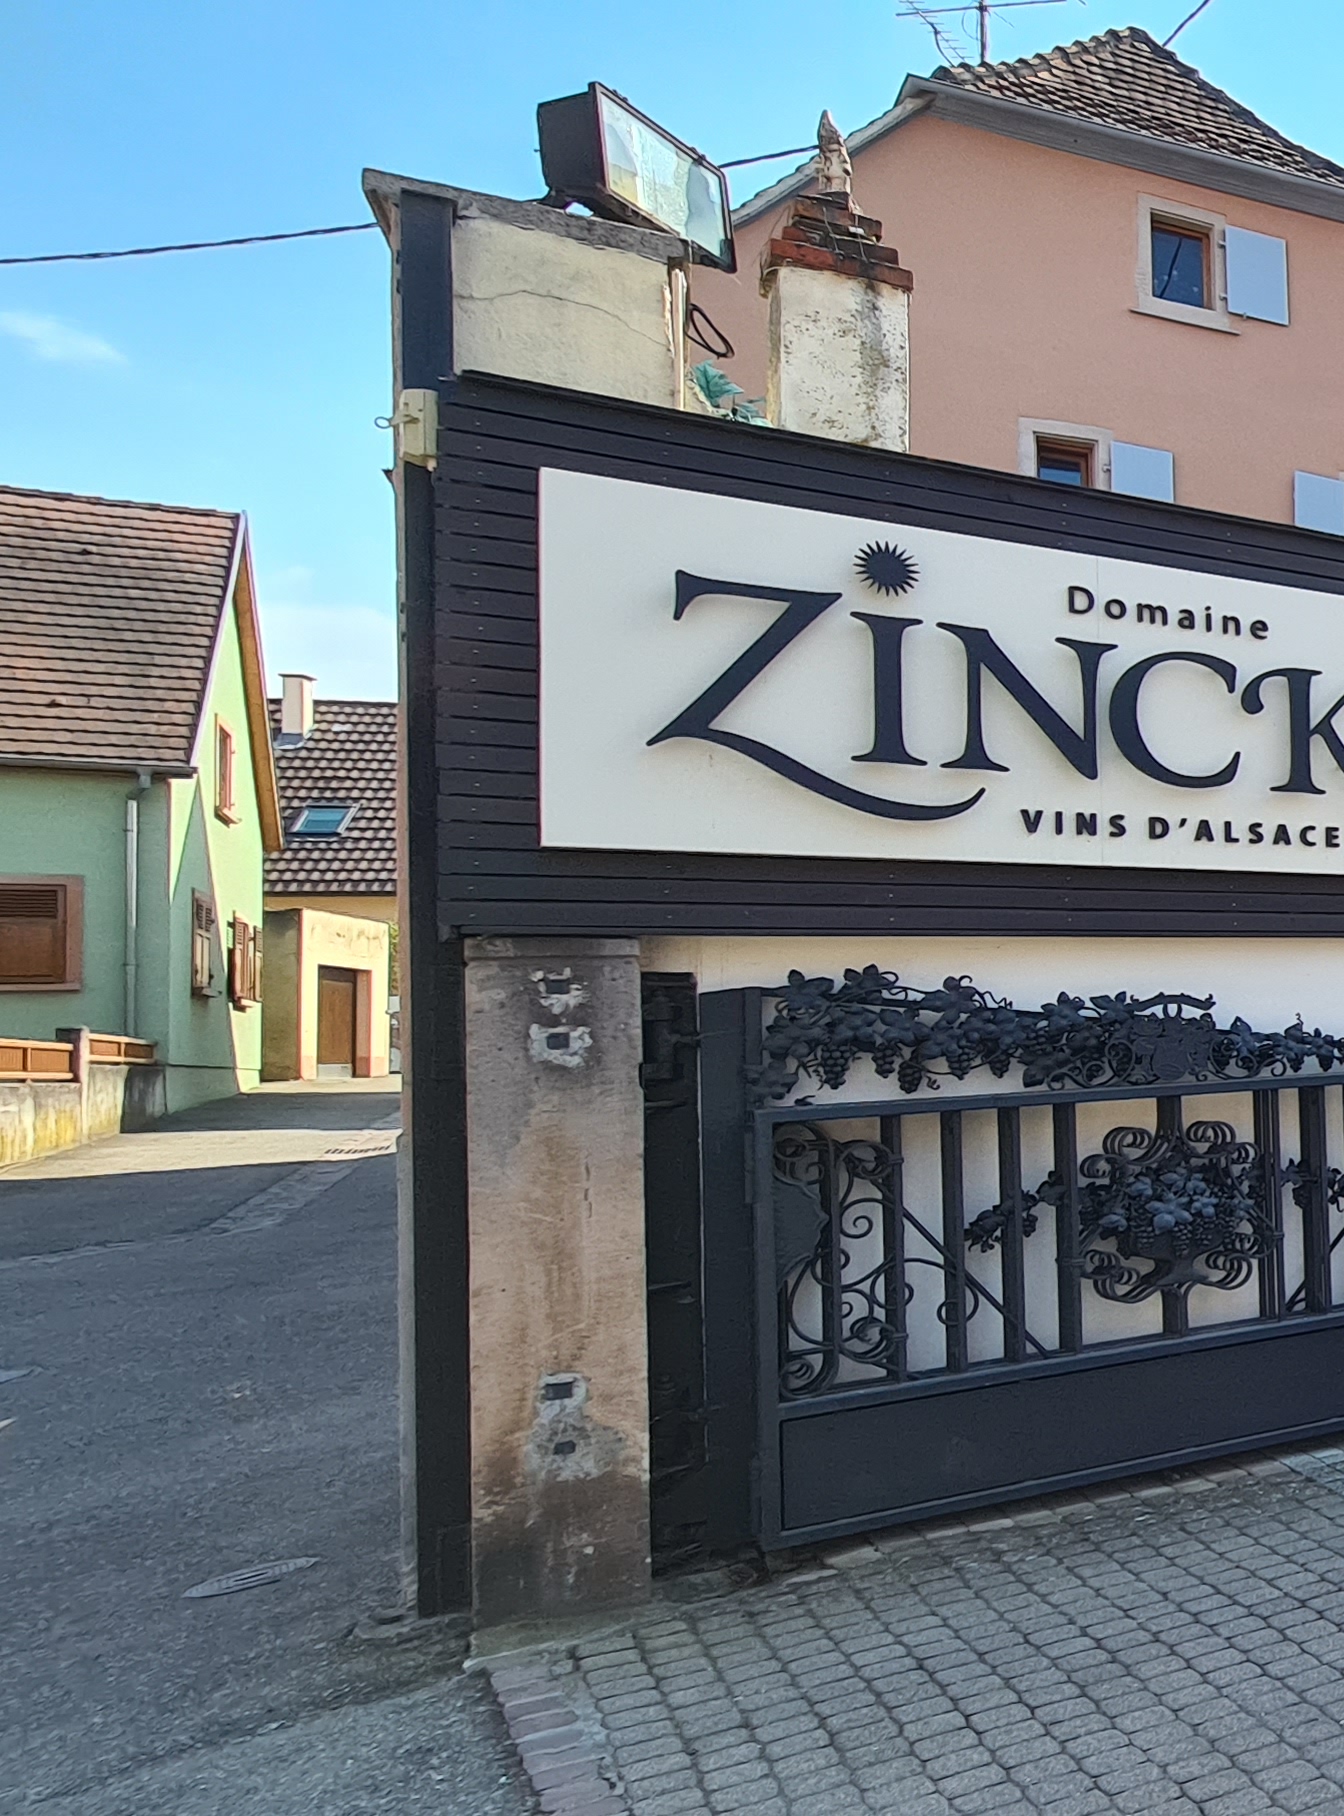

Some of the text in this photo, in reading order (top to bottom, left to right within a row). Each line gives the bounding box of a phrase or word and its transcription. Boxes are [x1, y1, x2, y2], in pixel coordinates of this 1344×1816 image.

[1067, 585, 1269, 640] Domaine
[1019, 808, 1342, 849] VINS D'ALSACE
